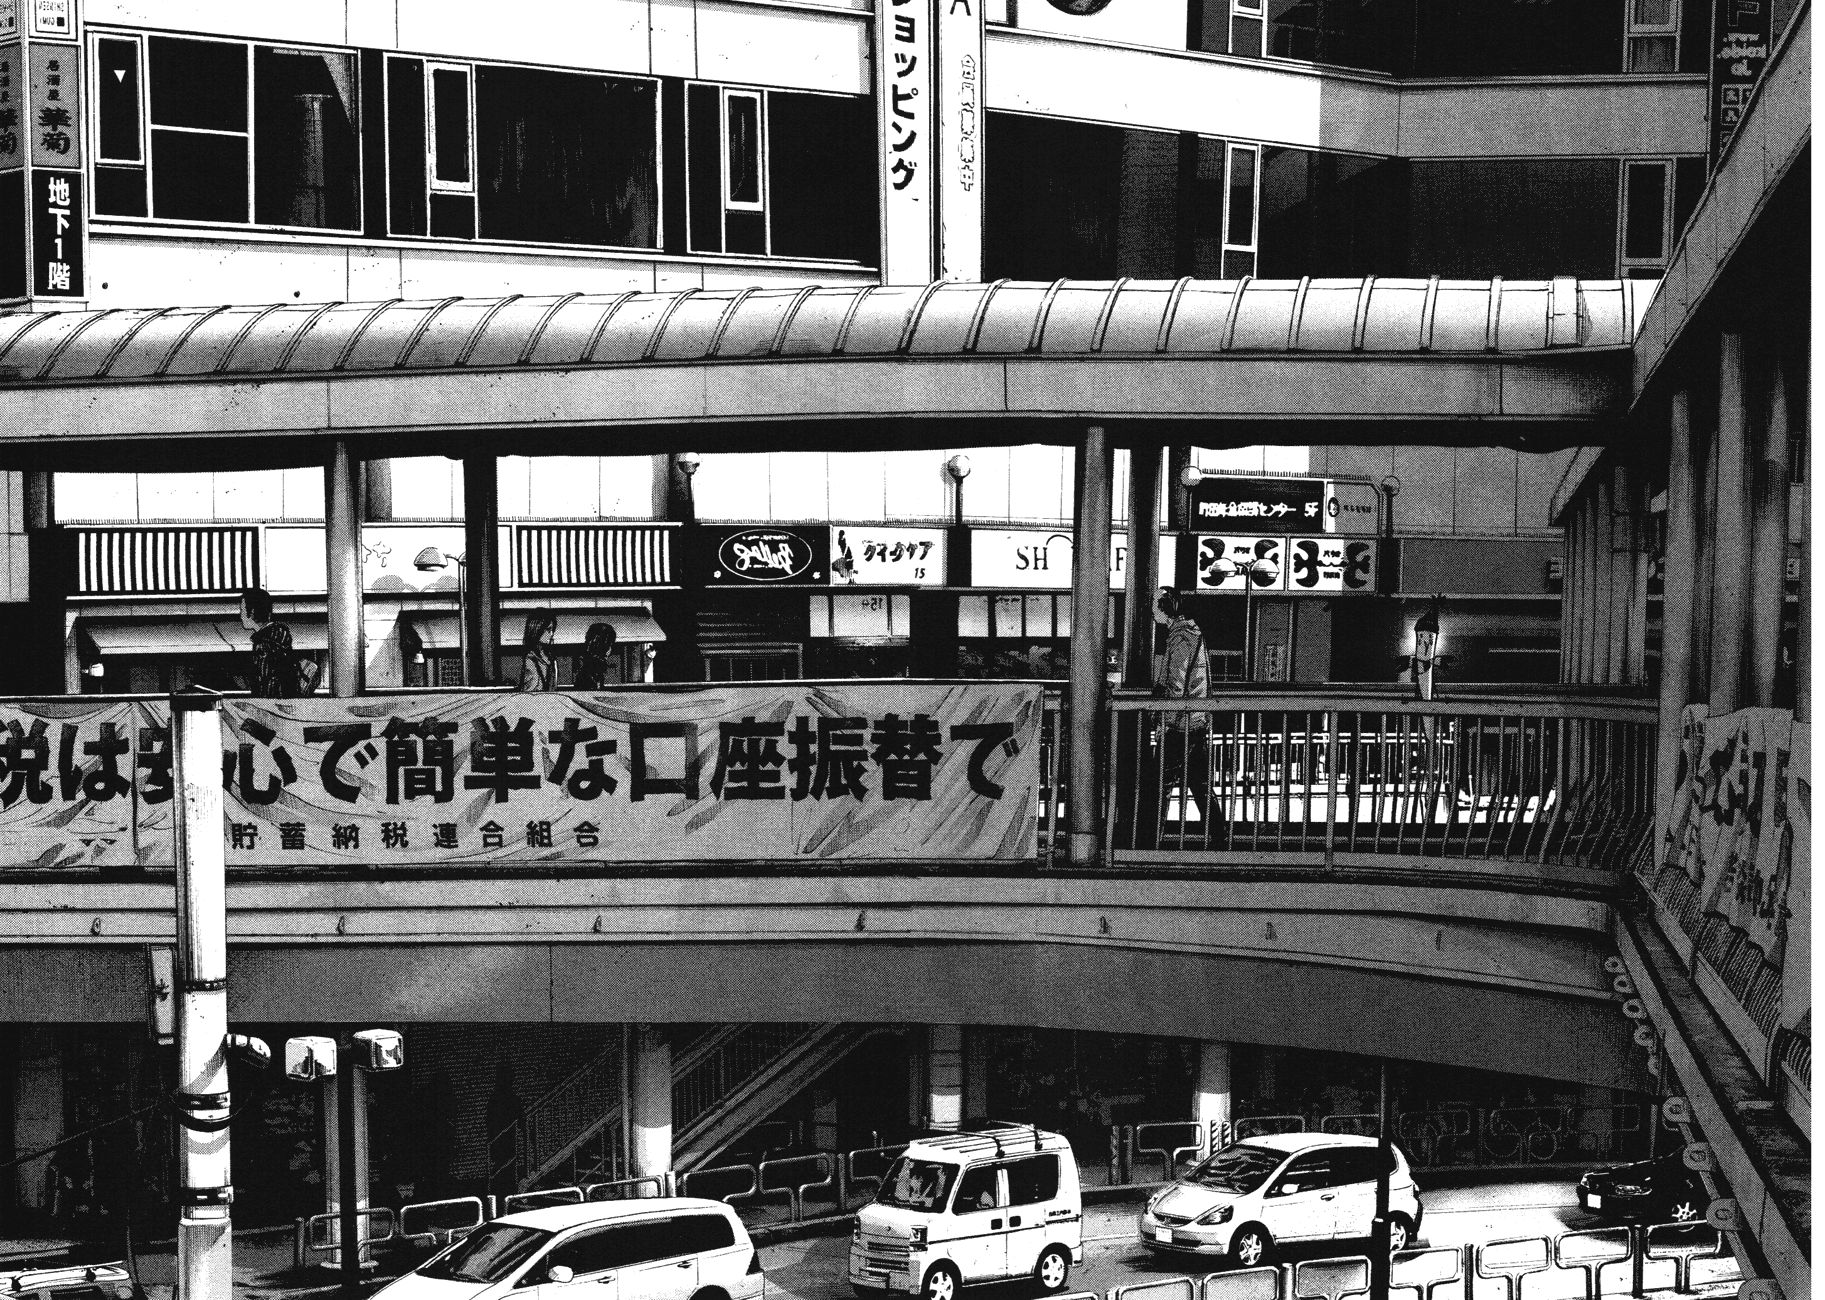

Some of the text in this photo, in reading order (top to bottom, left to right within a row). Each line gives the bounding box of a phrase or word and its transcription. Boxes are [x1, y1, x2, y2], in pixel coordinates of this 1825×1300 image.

[889, 0, 919, 191] ョッピング
[47, 176, 71, 290] 地下1階
[914, 567, 926, 579] 15
[231, 820, 601, 851] 貯蓄納税連合組合
